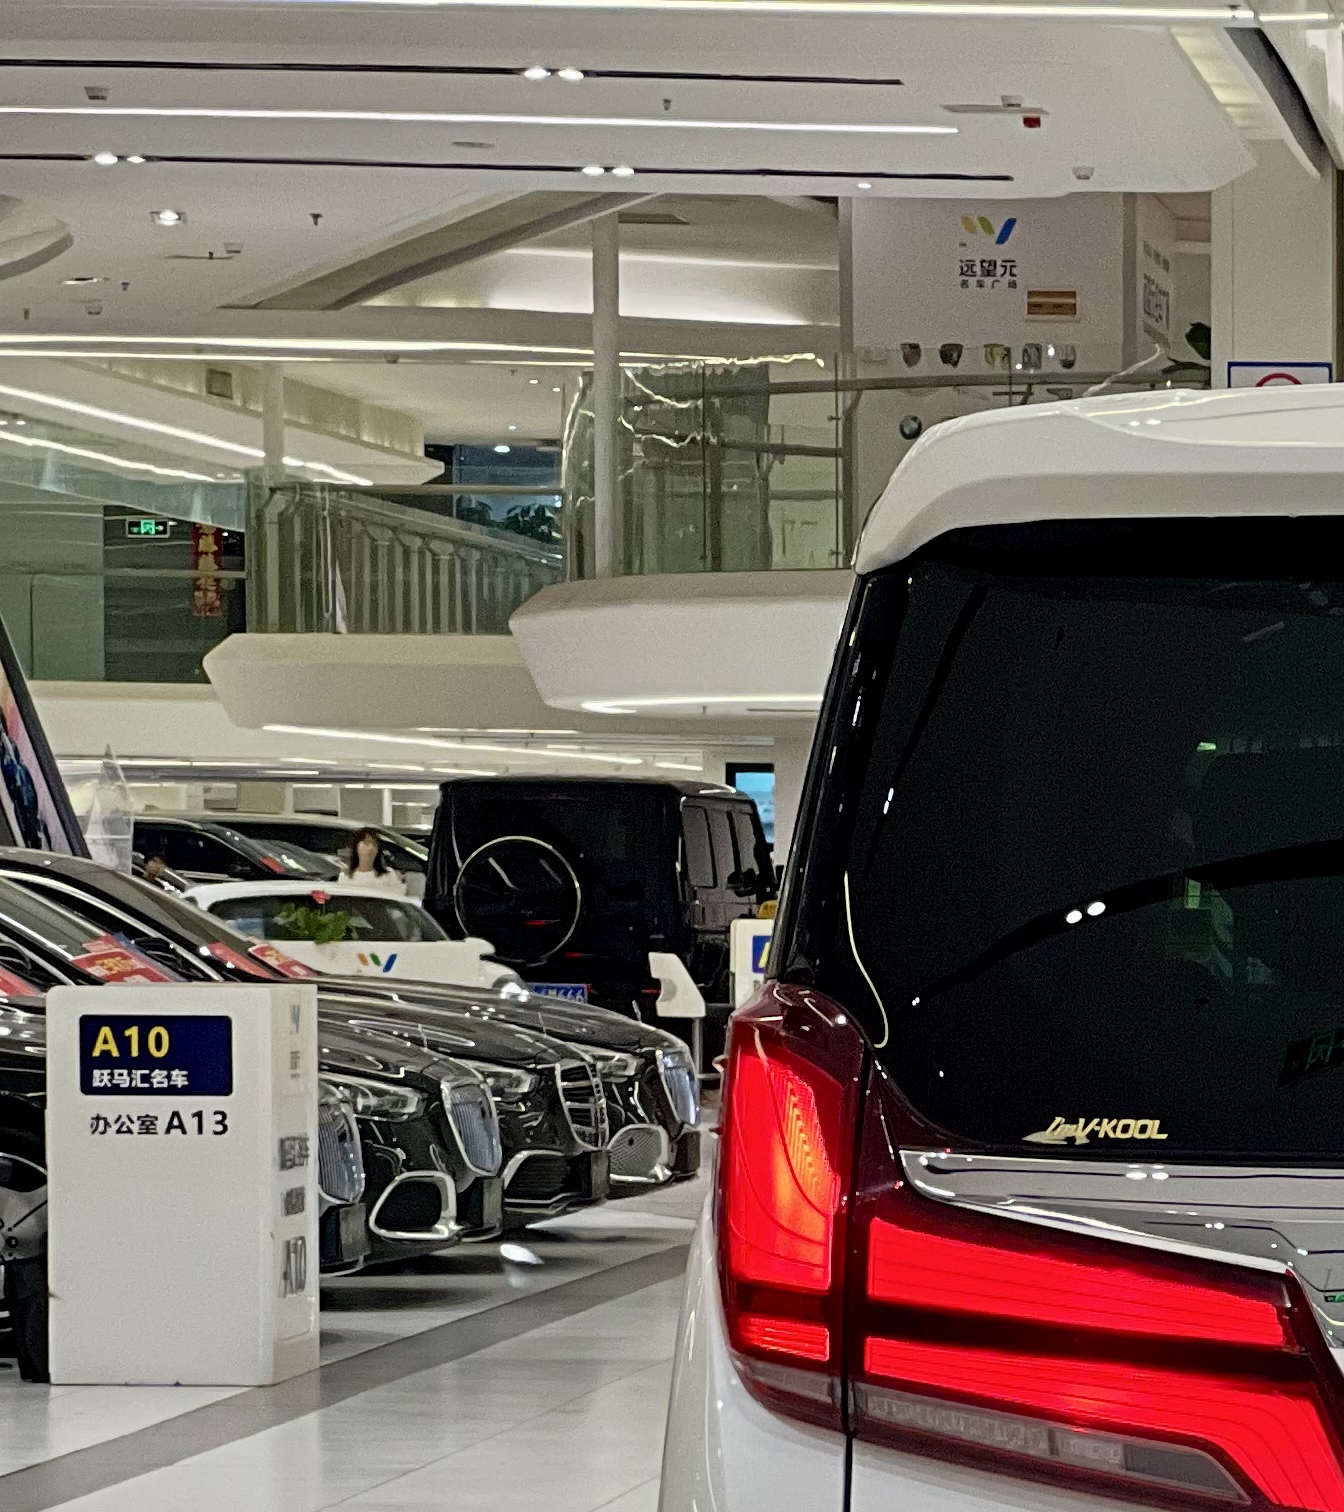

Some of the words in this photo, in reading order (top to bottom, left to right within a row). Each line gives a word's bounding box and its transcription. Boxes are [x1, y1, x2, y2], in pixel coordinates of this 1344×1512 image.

[958, 259, 1018, 278] 远望元
[960, 279, 1018, 290] 名车广场
[91, 1025, 170, 1058] A10
[92, 1068, 189, 1089] 跃马汇名车
